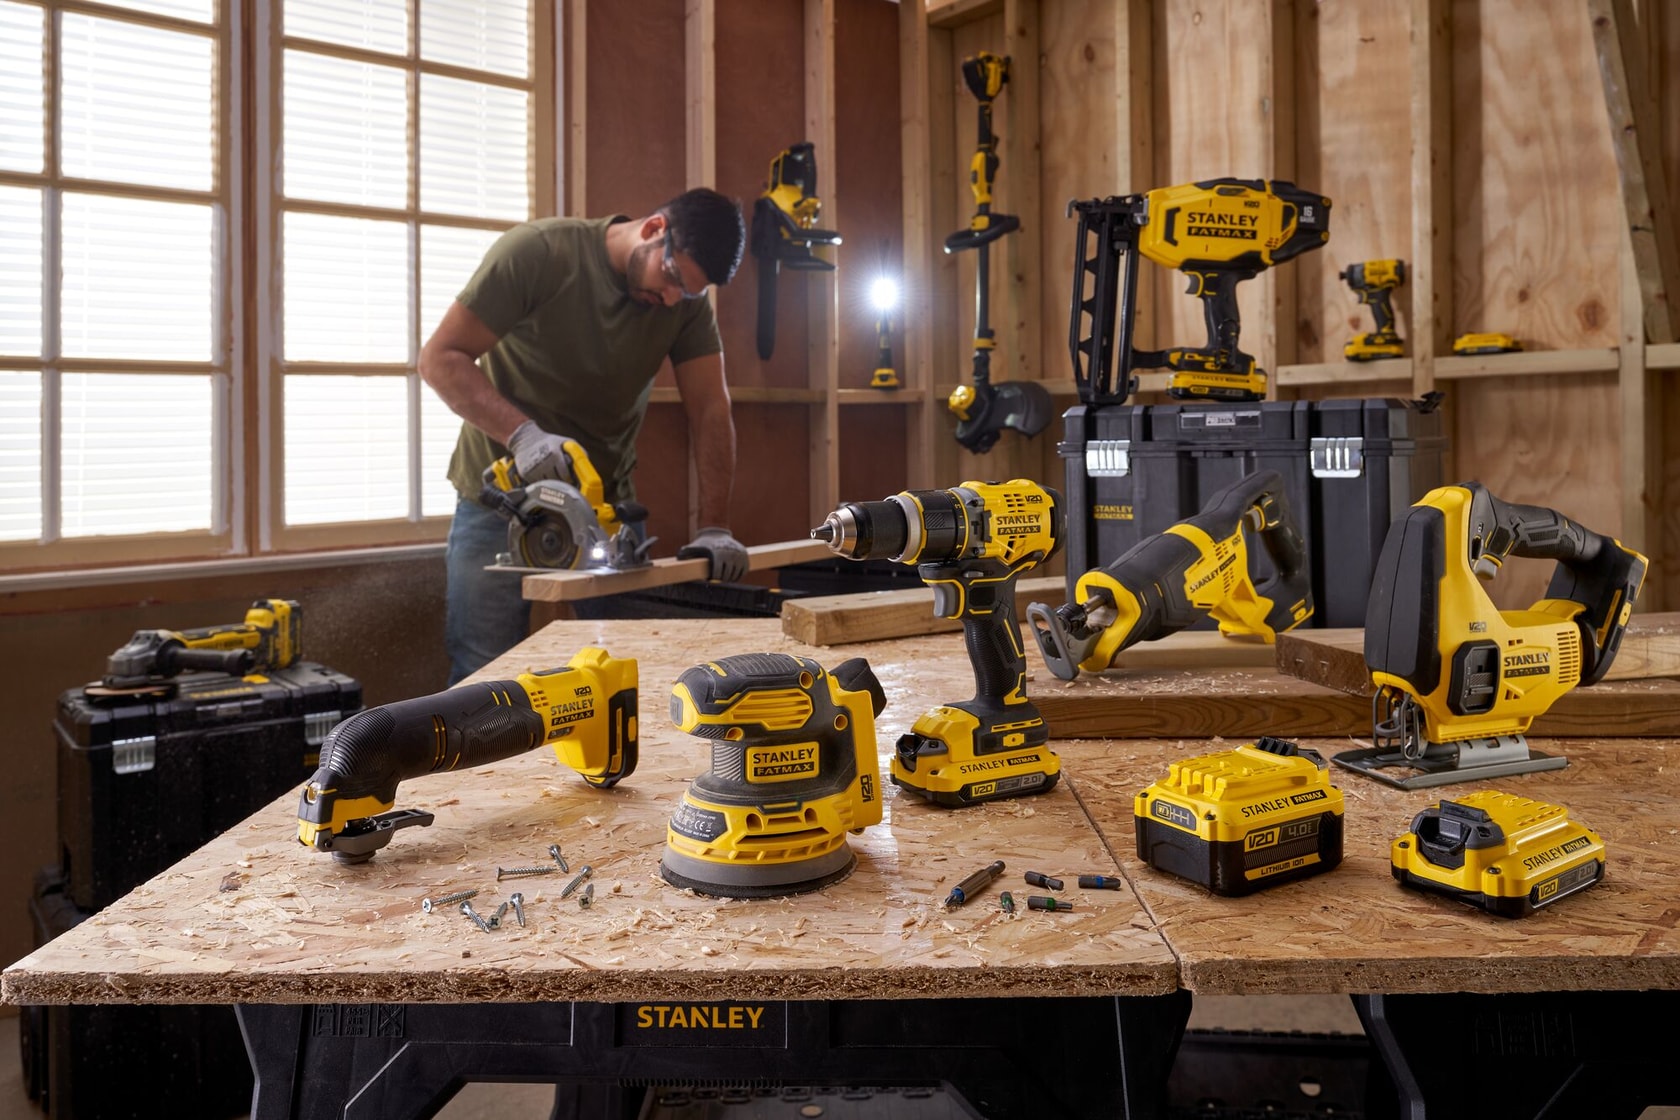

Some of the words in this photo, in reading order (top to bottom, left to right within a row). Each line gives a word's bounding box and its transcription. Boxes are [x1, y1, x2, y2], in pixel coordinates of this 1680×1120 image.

[1188, 212, 1259, 227] STANLEY
[1189, 228, 1255, 239] FATMAX
[996, 514, 1040, 525] STANLEY
[999, 526, 1039, 534] FATMAX
[1190, 568, 1219, 593] STANLEY
[1469, 622, 1487, 631] V20
[1504, 653, 1549, 667] STANLEY
[1506, 667, 1548, 677] FATMAX
[574, 686, 592, 696] V20
[550, 698, 594, 716] STANLEY
[553, 711, 592, 724] FATMAX
[753, 748, 814, 764] STANLEY
[756, 763, 812, 776] FATMAX
[960, 760, 1005, 774] STANLEY
[1009, 756, 1038, 765] FATMAX
[860, 774, 870, 803] V20
[974, 785, 992, 795] V20
[1024, 776, 1037, 784] 2.0
[1241, 797, 1290, 818] STANLEY
[1294, 791, 1324, 804] FATMAX
[1248, 831, 1274, 848] V20
[1288, 824, 1307, 837] 4.0
[1523, 847, 1563, 871] STANLEY
[1566, 838, 1590, 853] FATMAX
[1261, 862, 1290, 875] LITHIUM
[1540, 881, 1556, 897] V20
[637, 1006, 765, 1028] STANLEY
